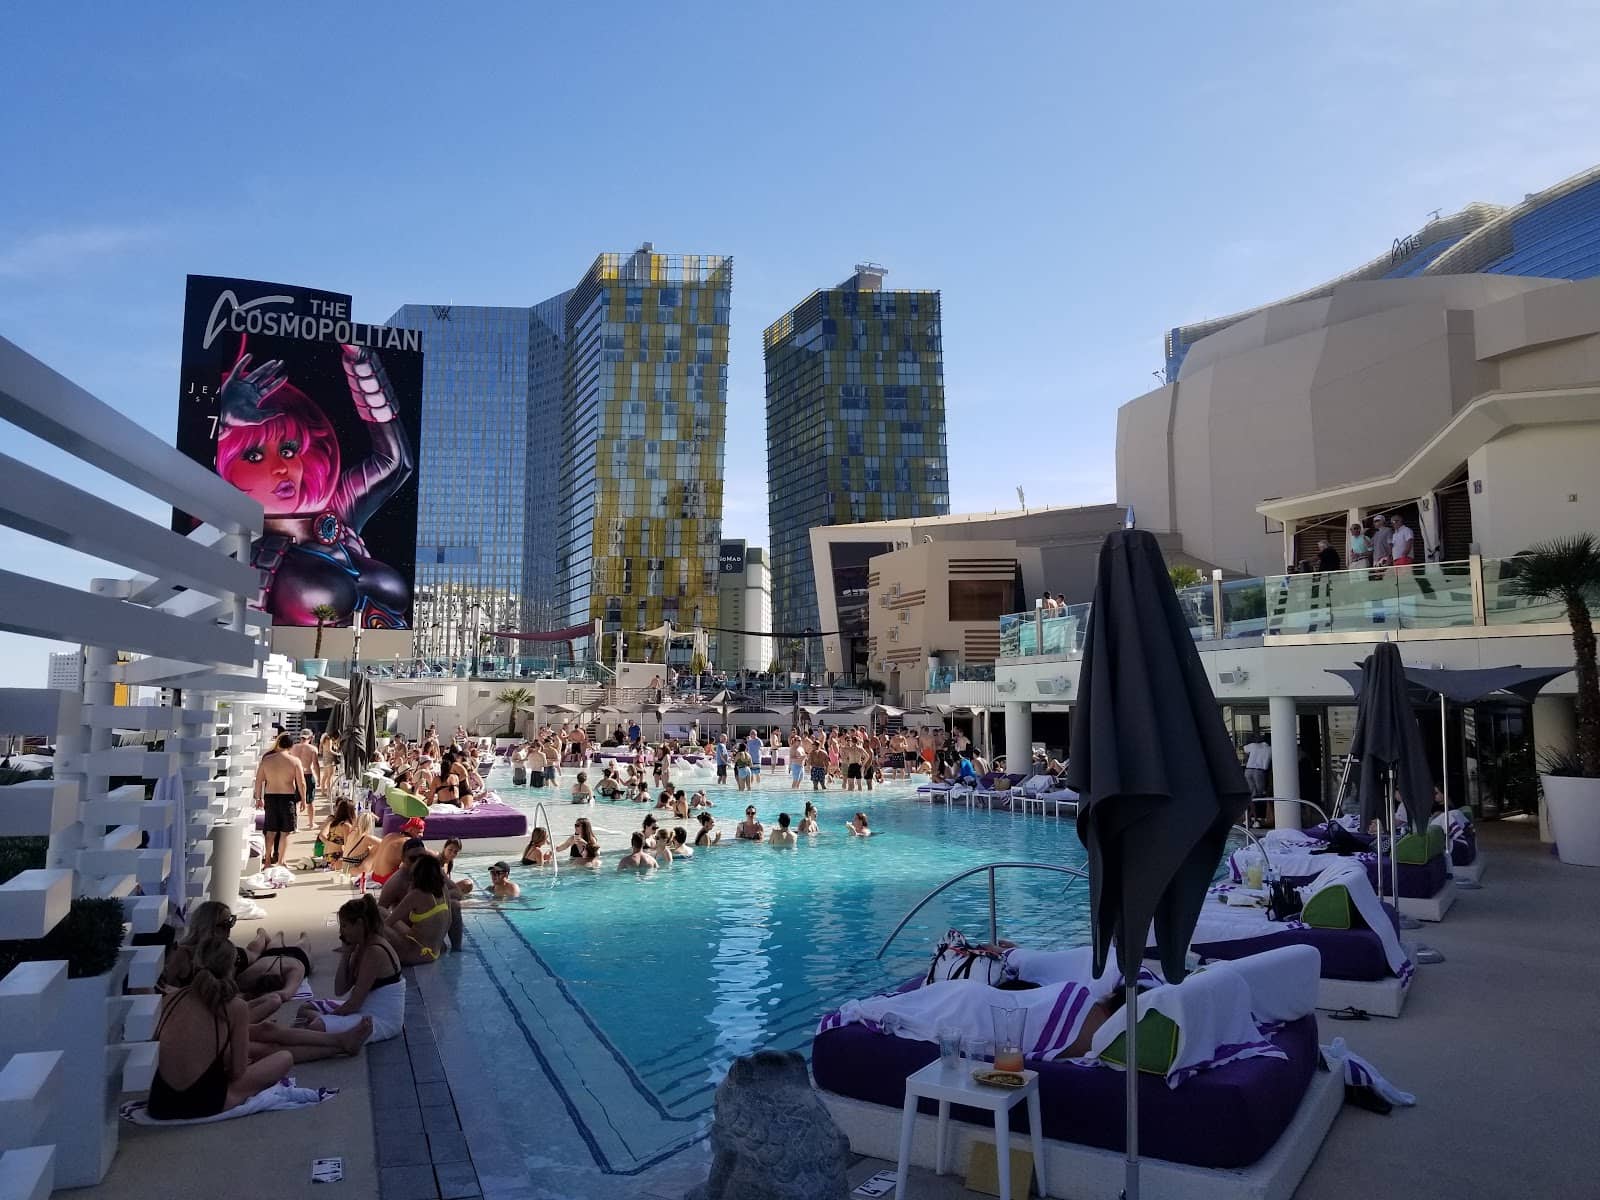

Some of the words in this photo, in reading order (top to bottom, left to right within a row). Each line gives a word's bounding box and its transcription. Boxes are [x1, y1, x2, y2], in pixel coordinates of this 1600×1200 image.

[310, 299, 347, 318] THE
[230, 309, 419, 352] COSMOPOLITAN
[207, 415, 219, 439] 7
